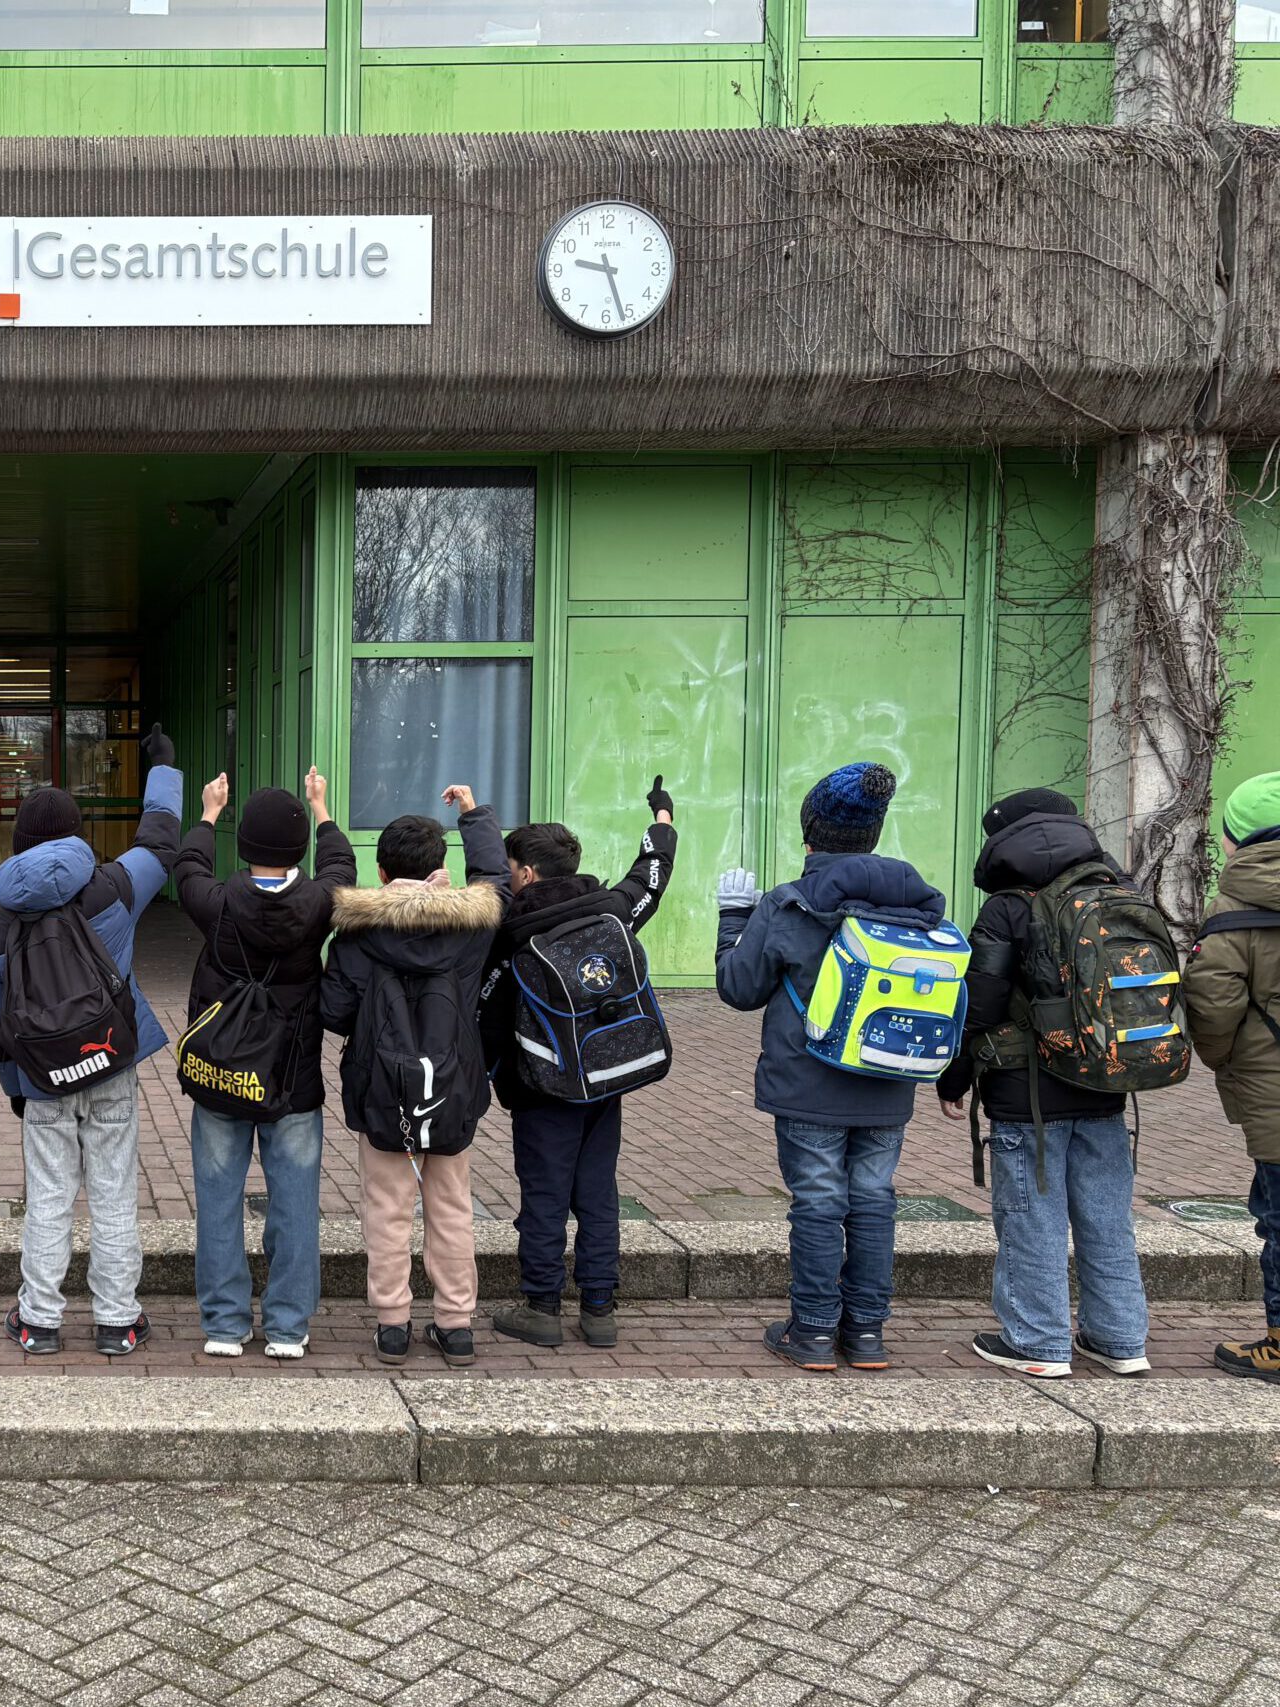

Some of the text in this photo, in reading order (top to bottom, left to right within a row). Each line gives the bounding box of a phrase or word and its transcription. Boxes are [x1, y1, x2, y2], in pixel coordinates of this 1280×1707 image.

[578, 221, 590, 235] 11
[600, 214, 615, 229] 12
[627, 220, 634, 235] 1
[560, 239, 576, 253] 10
[642, 237, 653, 252] 2
[553, 263, 563, 278] 9
[651, 262, 661, 277] 3
[561, 287, 571, 302] 8
[642, 286, 652, 300] 4
[579, 304, 588, 319] 7
[601, 309, 611, 324] 6
[624, 304, 634, 318] 5
[48, 1051, 111, 1086] PUMA
[187, 1052, 260, 1087] BORUSSIA
[182, 1062, 265, 1102] DORTMUND
